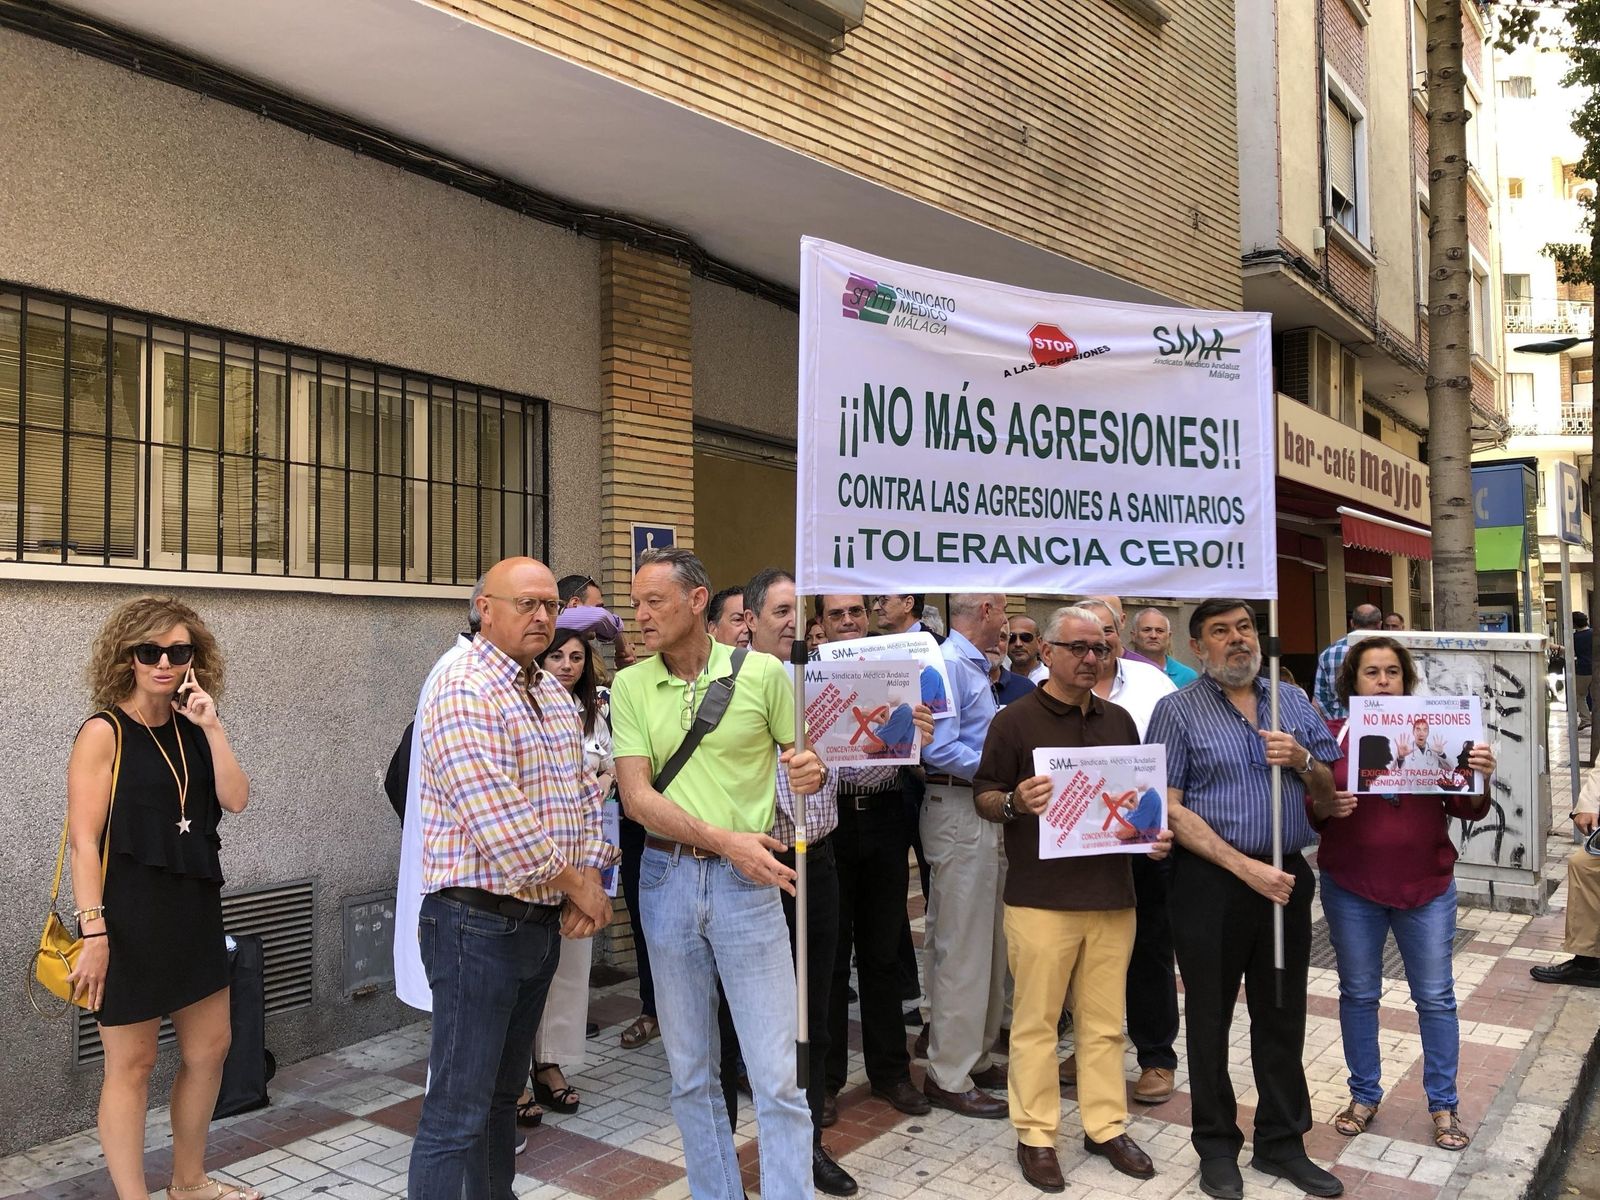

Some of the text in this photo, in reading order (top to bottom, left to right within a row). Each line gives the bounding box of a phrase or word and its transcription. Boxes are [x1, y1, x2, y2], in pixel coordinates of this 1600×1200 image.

[896, 287, 956, 313] SINDICATO
[893, 315, 948, 336] MÁLAGA
[1004, 345, 1111, 378] A LAS AGRESIONES
[1034, 337, 1075, 353] STOP
[1153, 358, 1183, 367] Sindicato
[1211, 362, 1240, 371] Andaluz
[1209, 370, 1240, 381] Málaga
[925, 381, 997, 454] MÁS
[1005, 401, 1241, 470] AGRESIONES!!
[1283, 421, 1422, 511] bar-café mayjo
[838, 472, 1245, 525] CONTRA LAS AGRESIONES A SANITARIOS
[1563, 471, 1577, 533] P
[833, 528, 1245, 570] ¡¡TOLERANCIA CERO!!
[805, 670, 829, 683] MA
[831, 671, 861, 680] Sindicato
[886, 671, 910, 679] Andaluz
[807, 689, 841, 726] UNCIA LAS
[807, 698, 843, 737] GRESIONES
[1363, 713, 1379, 726] NO
[1381, 713, 1404, 726] MAS
[1080, 758, 1109, 767] Sindicato
[1405, 768, 1451, 777] TRABAJAR
[1046, 769, 1085, 823] CONCIENCIATE
[1365, 779, 1407, 787] DIGNIDAD
[1050, 775, 1090, 829] DENUNCIA LAS
[1059, 784, 1093, 830] AGRESIONES
